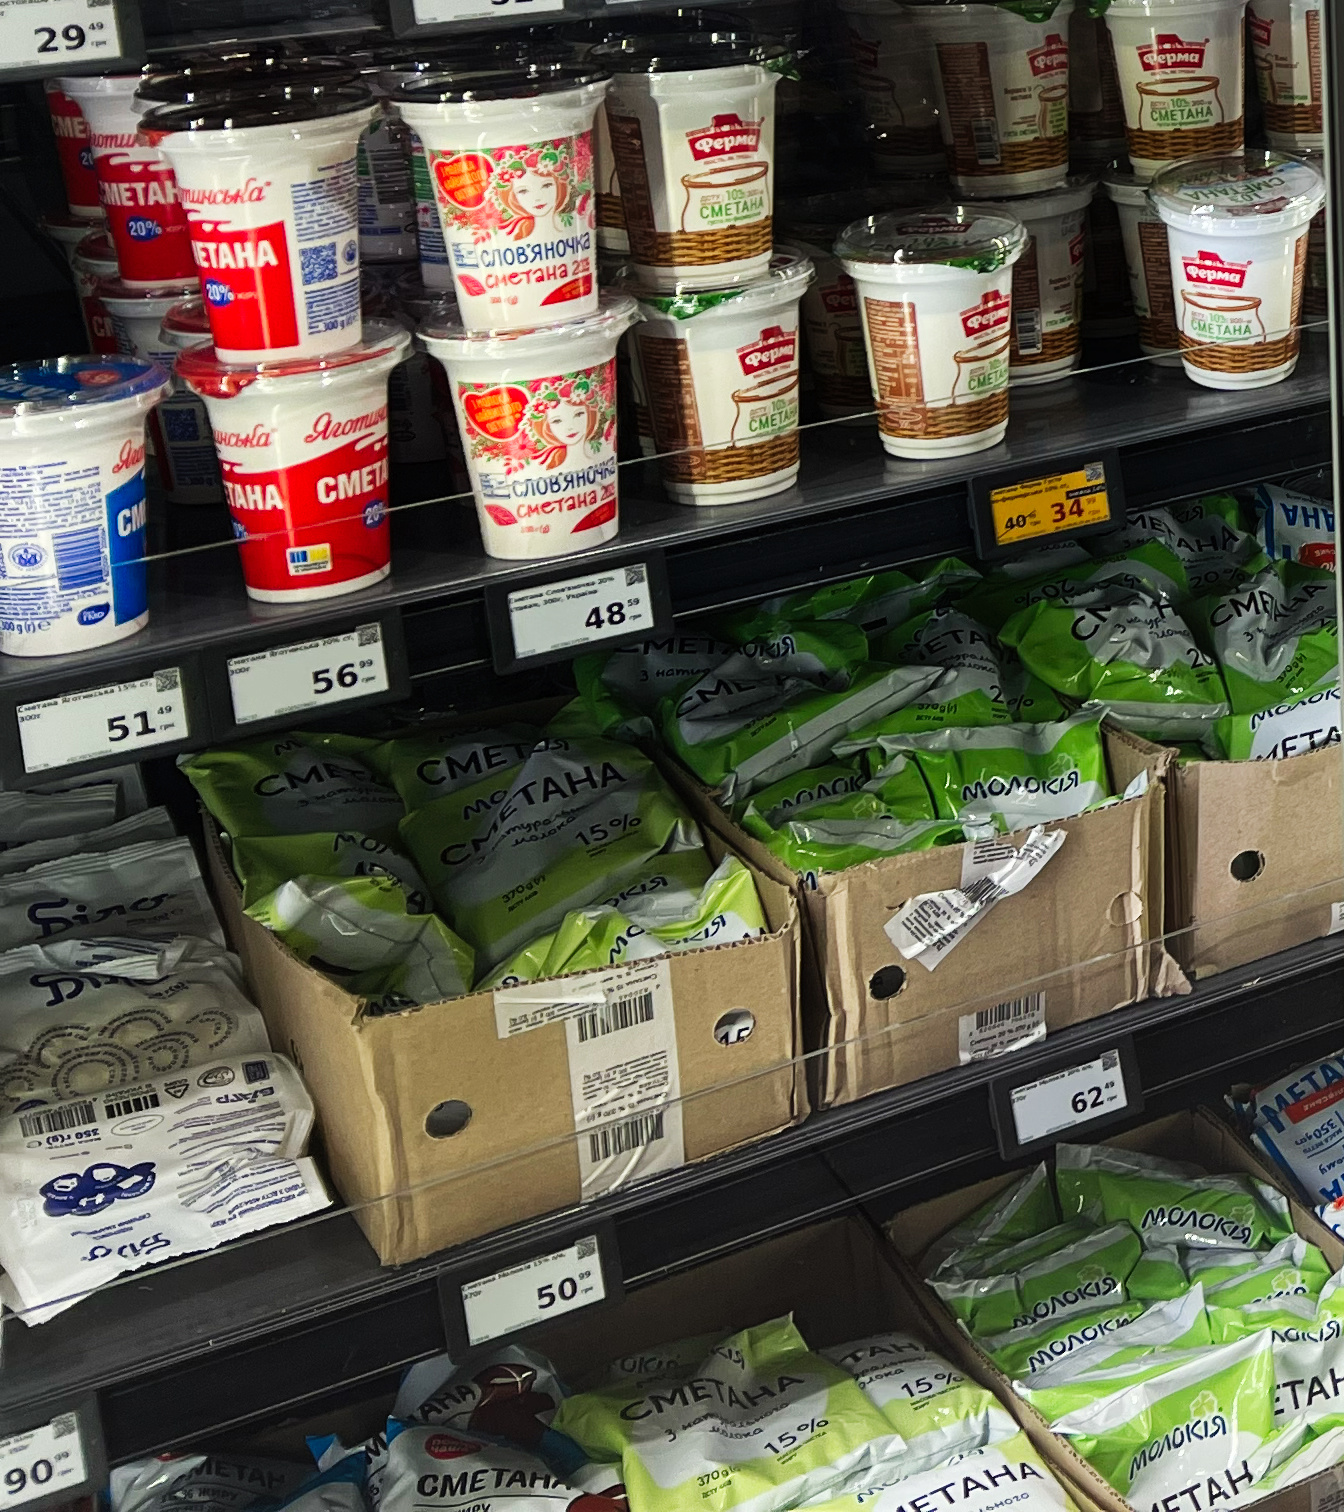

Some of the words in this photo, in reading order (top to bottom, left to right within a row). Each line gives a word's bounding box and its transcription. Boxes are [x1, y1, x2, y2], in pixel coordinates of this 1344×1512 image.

[34, 24, 86, 53] 29
[88, 22, 105, 32] 49
[1142, 49, 1202, 67] Ферма
[1150, 105, 1214, 124] СМЕТАНА
[694, 134, 760, 155] Ферма
[183, 178, 265, 205] тинська
[699, 198, 765, 220] СМЕТАНА
[1185, 265, 1243, 285] Ферма
[1190, 319, 1252, 338] СМЕТАНА
[744, 343, 795, 366] Ферма
[1050, 499, 1085, 524] 34
[584, 602, 627, 630] 48
[312, 664, 359, 695] 56
[106, 710, 156, 743] 51
[156, 705, 172, 716] 49
[574, 813, 642, 847] 15%
[1070, 1085, 1106, 1114] 62
[537, 1278, 578, 1309] 50
[763, 1417, 830, 1455] 15%
[4, 1460, 53, 1492] 90
